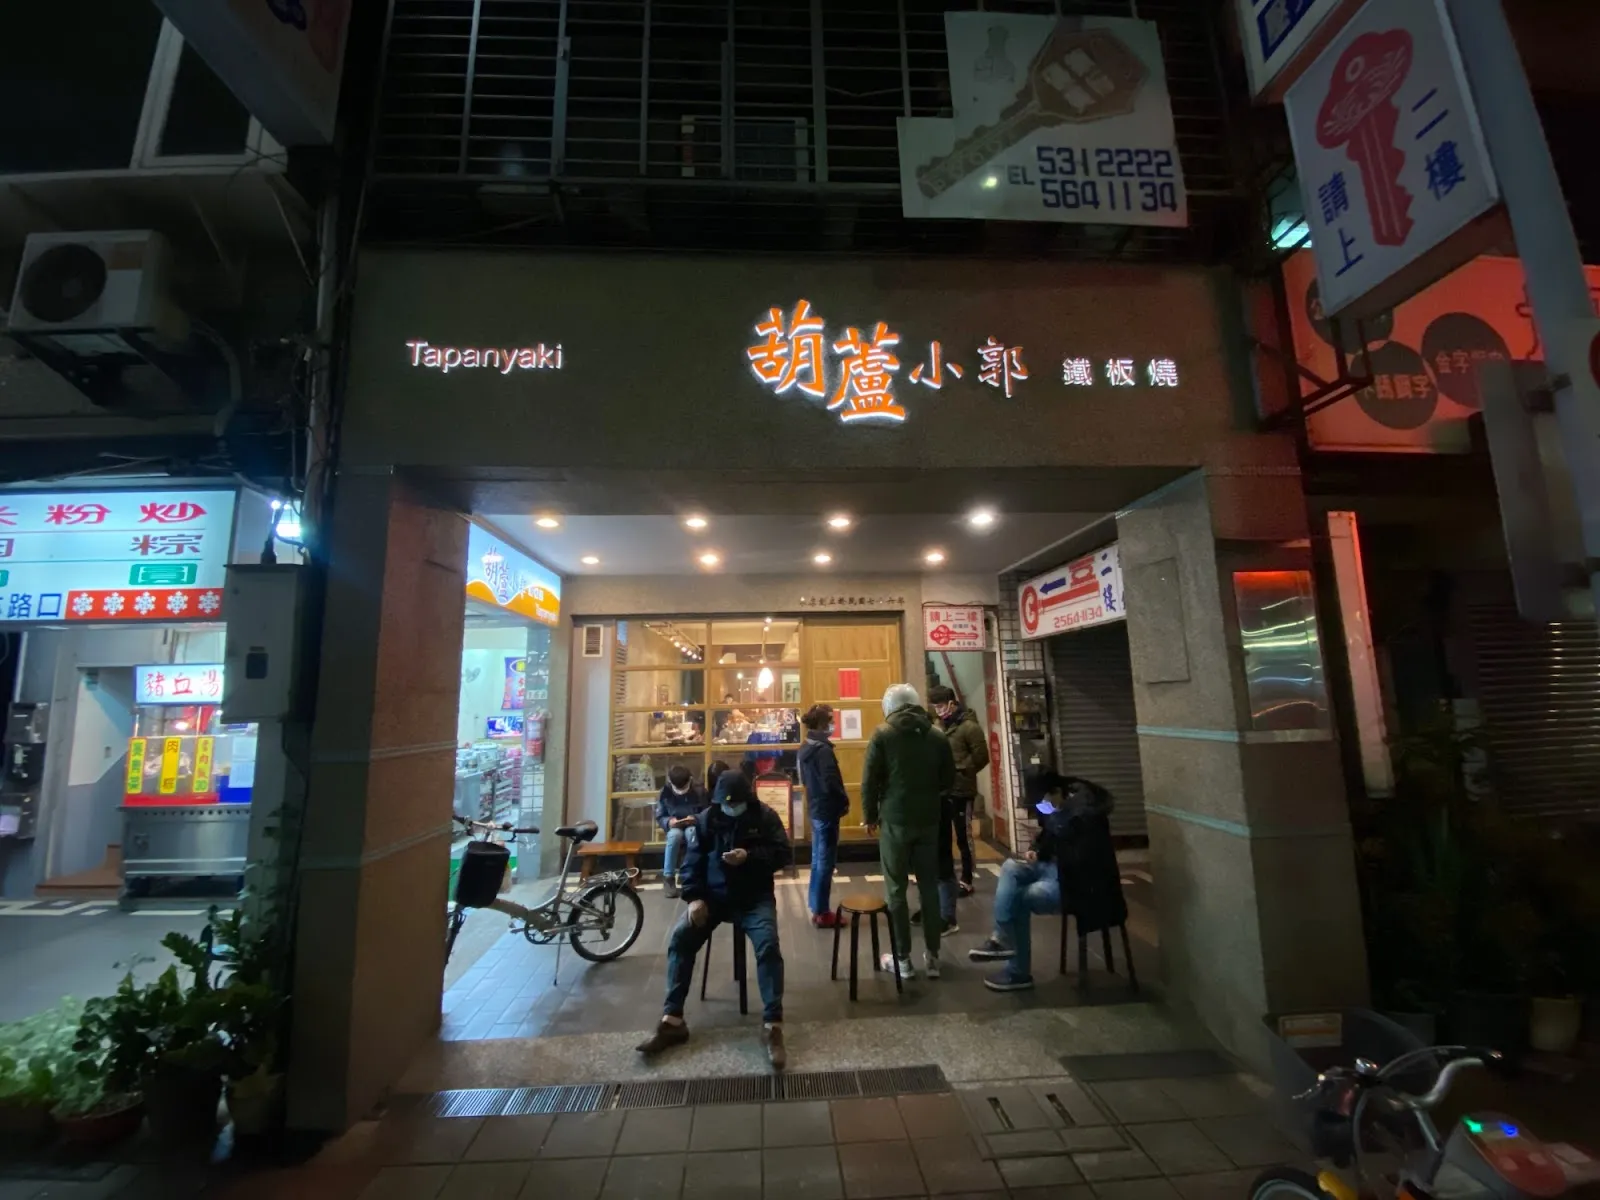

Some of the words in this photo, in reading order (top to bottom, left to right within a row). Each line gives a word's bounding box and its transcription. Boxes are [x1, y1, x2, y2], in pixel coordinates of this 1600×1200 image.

[1411, 88, 1466, 200] 二樓
[1036, 146, 1175, 179] 5312222
[1041, 179, 1178, 212] 5641134
[1318, 171, 1363, 278] 請上
[406, 341, 563, 375] Tapanyaki
[747, 299, 1028, 421] 葫蘆小郭
[1062, 357, 1180, 388] 鐵板燒
[0, 593, 62, 620] 路口
[145, 669, 221, 698] 豬血湯
